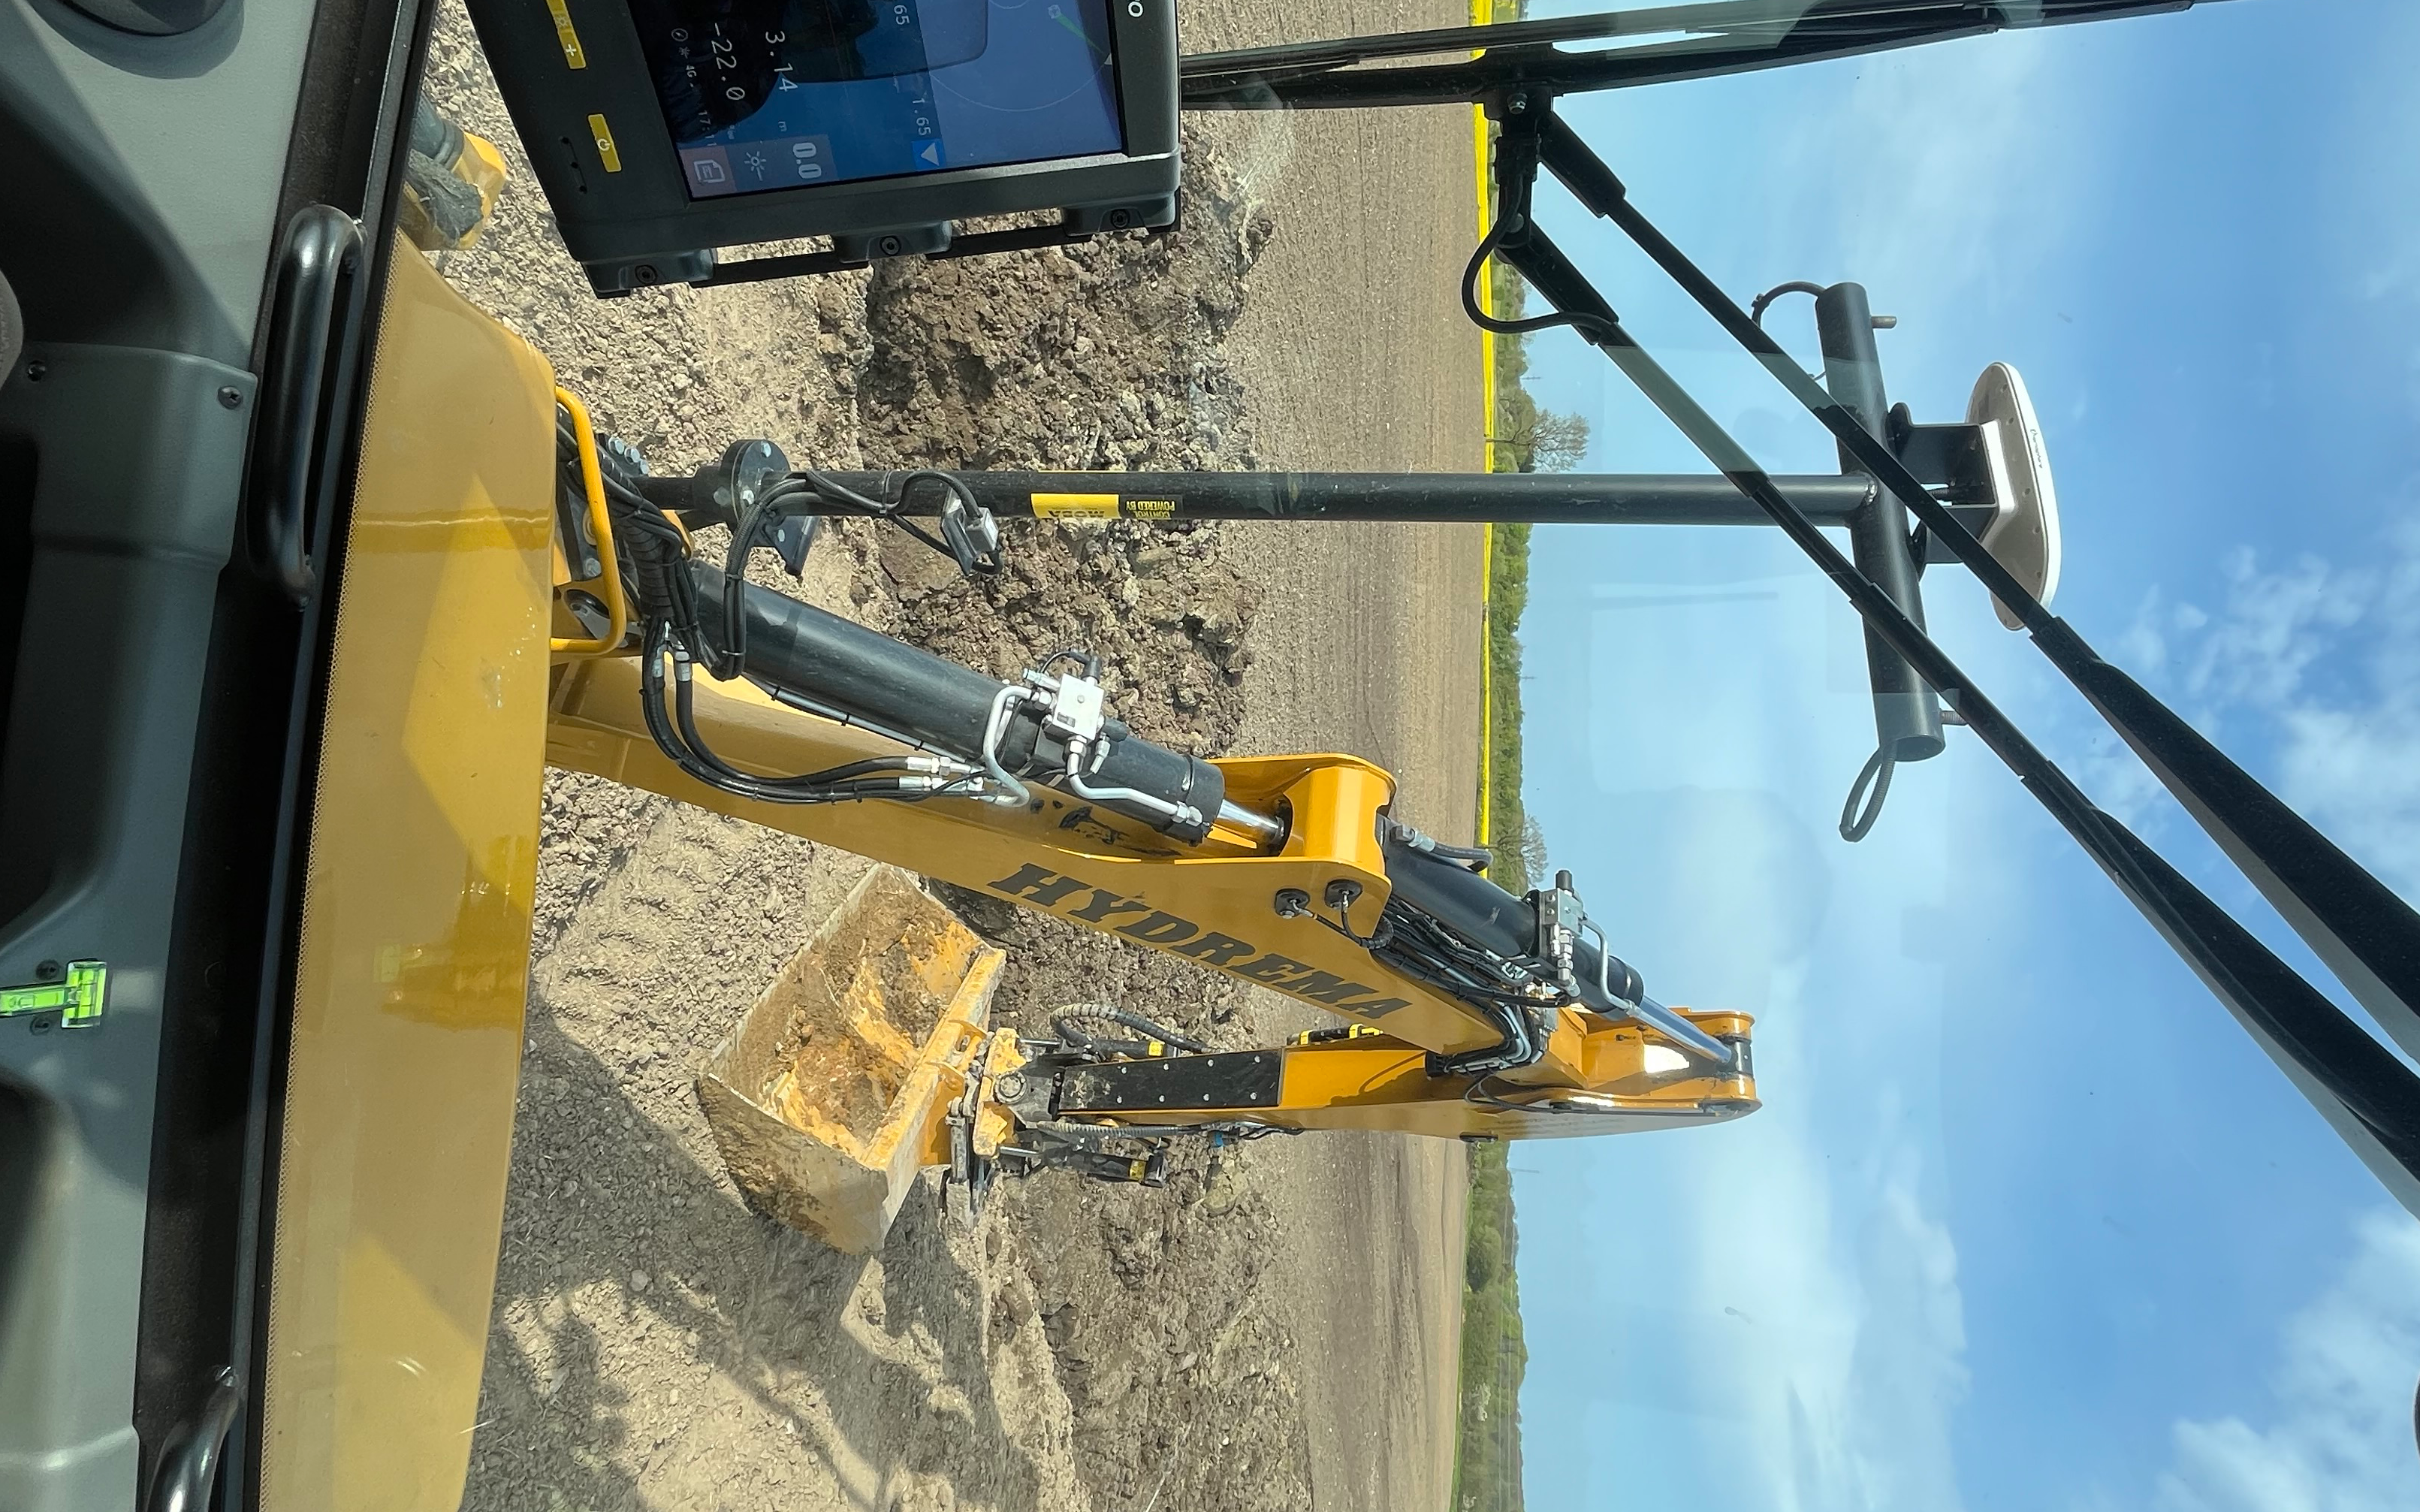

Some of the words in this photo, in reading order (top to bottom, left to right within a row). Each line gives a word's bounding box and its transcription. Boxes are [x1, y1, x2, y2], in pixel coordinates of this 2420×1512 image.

[711, 23, 746, 101] -22.0
[765, 30, 798, 92] 3.14
[912, 98, 932, 137] 1.65
[792, 141, 822, 180] 0.0
[1126, 501, 1136, 511] BY
[1134, 511, 1172, 520] CONTROL
[1138, 501, 1176, 512] POWERED
[988, 862, 1414, 1021] HYDREMA
